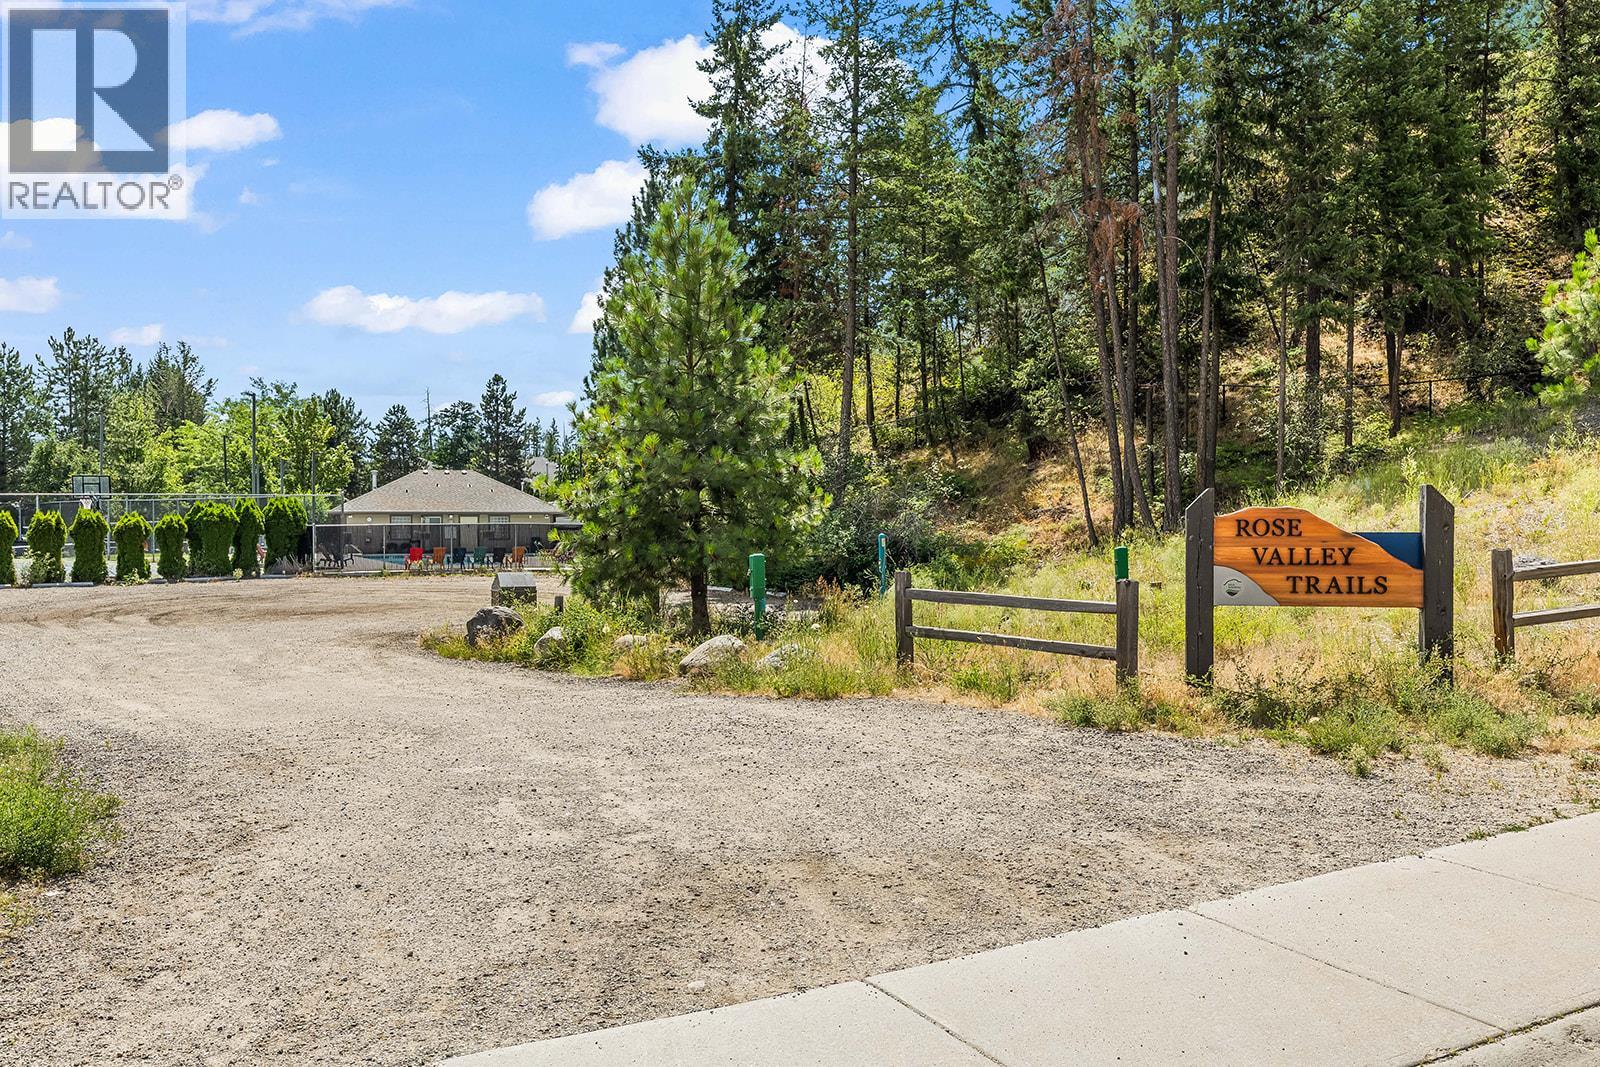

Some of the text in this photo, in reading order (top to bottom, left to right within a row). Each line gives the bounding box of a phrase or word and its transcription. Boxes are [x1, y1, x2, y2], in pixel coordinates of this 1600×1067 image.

[1235, 518, 1303, 537] ROSE
[1251, 547, 1356, 566] VALLEY
[1286, 575, 1388, 595] TRAILS
